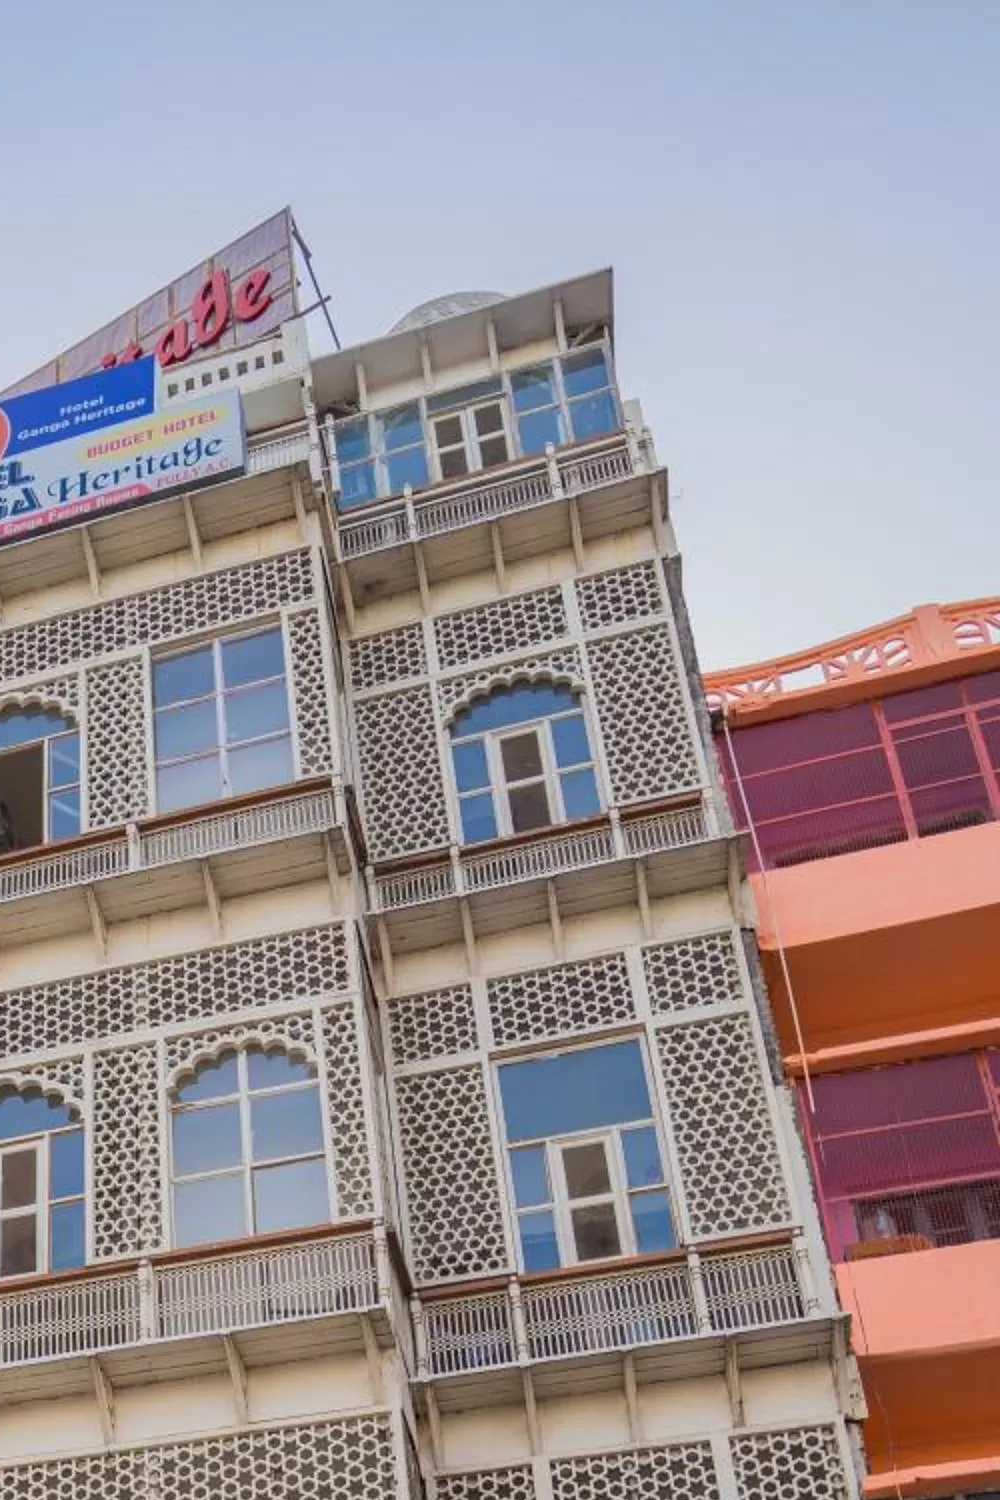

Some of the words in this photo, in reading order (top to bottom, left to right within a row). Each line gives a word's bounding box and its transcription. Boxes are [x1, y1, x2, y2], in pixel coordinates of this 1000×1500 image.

[17, 419, 70, 440] Ganga
[73, 397, 147, 425] Heritage
[60, 395, 104, 416] Hotel
[87, 428, 154, 458] BUDGET
[163, 409, 217, 435] HOTEL
[47, 437, 223, 503] Heritage
